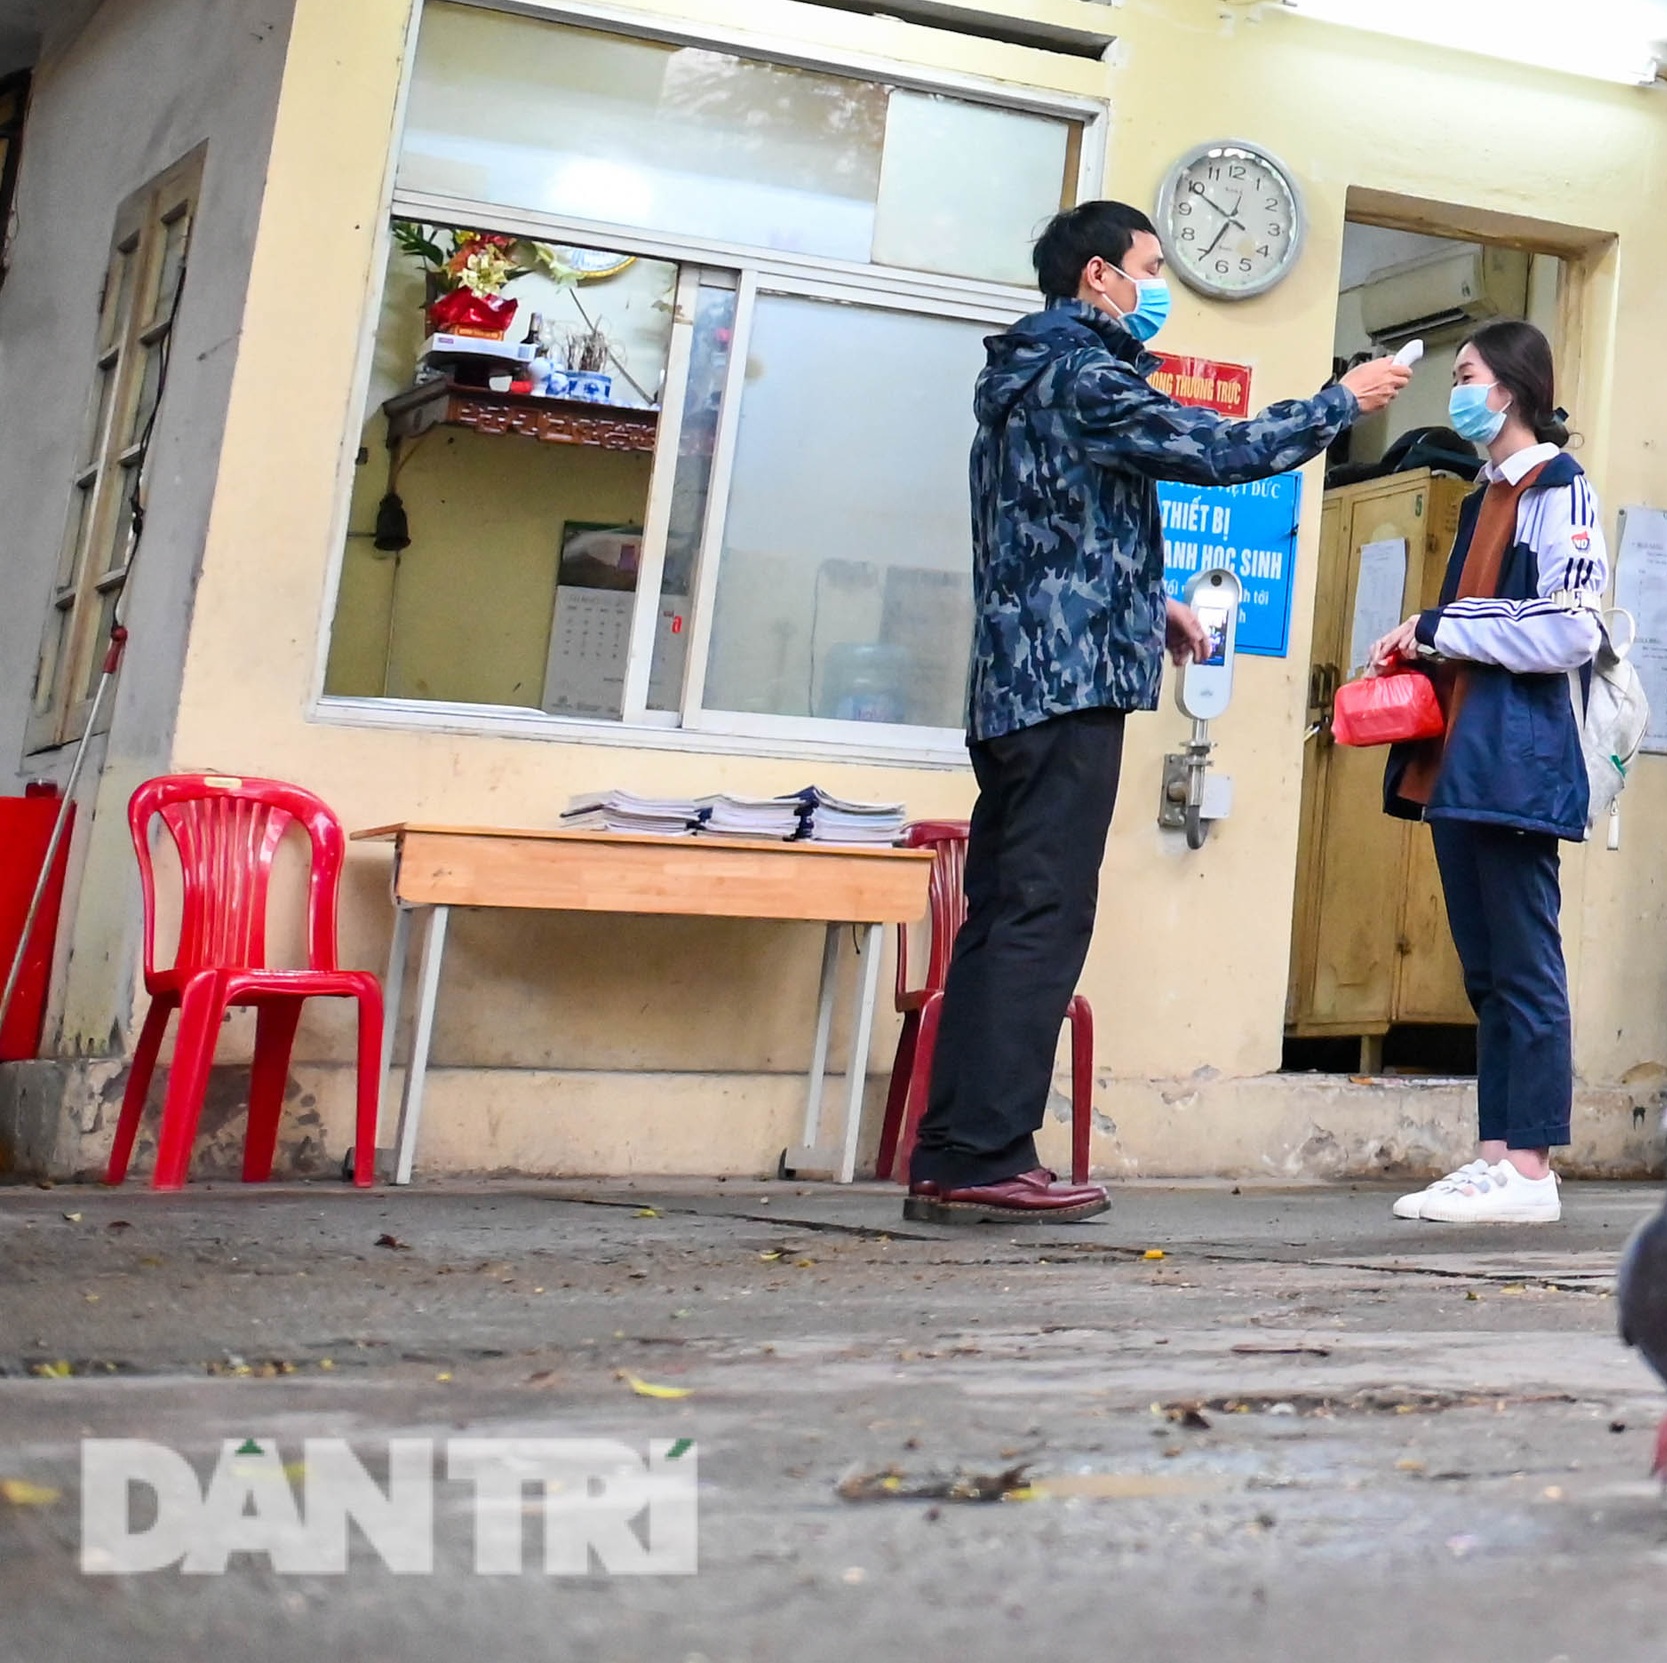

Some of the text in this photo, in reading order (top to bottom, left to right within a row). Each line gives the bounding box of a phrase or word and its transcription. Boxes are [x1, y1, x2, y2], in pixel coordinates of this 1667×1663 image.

[1208, 166, 1221, 181] 11
[1229, 165, 1247, 180] 12
[1188, 180, 1205, 195] 10
[1178, 202, 1192, 216] 9
[1265, 197, 1278, 212] 2
[1181, 227, 1195, 241] 8
[1267, 223, 1281, 237] 3
[1256, 245, 1269, 258] 4
[1215, 260, 1229, 274] 6
[1239, 258, 1252, 272] 5
[1415, 495, 1423, 517] 5
[1162, 496, 1231, 541] THIẾT BỊ
[1164, 539, 1198, 571] ANH
[1240, 547, 1283, 580] SINH
